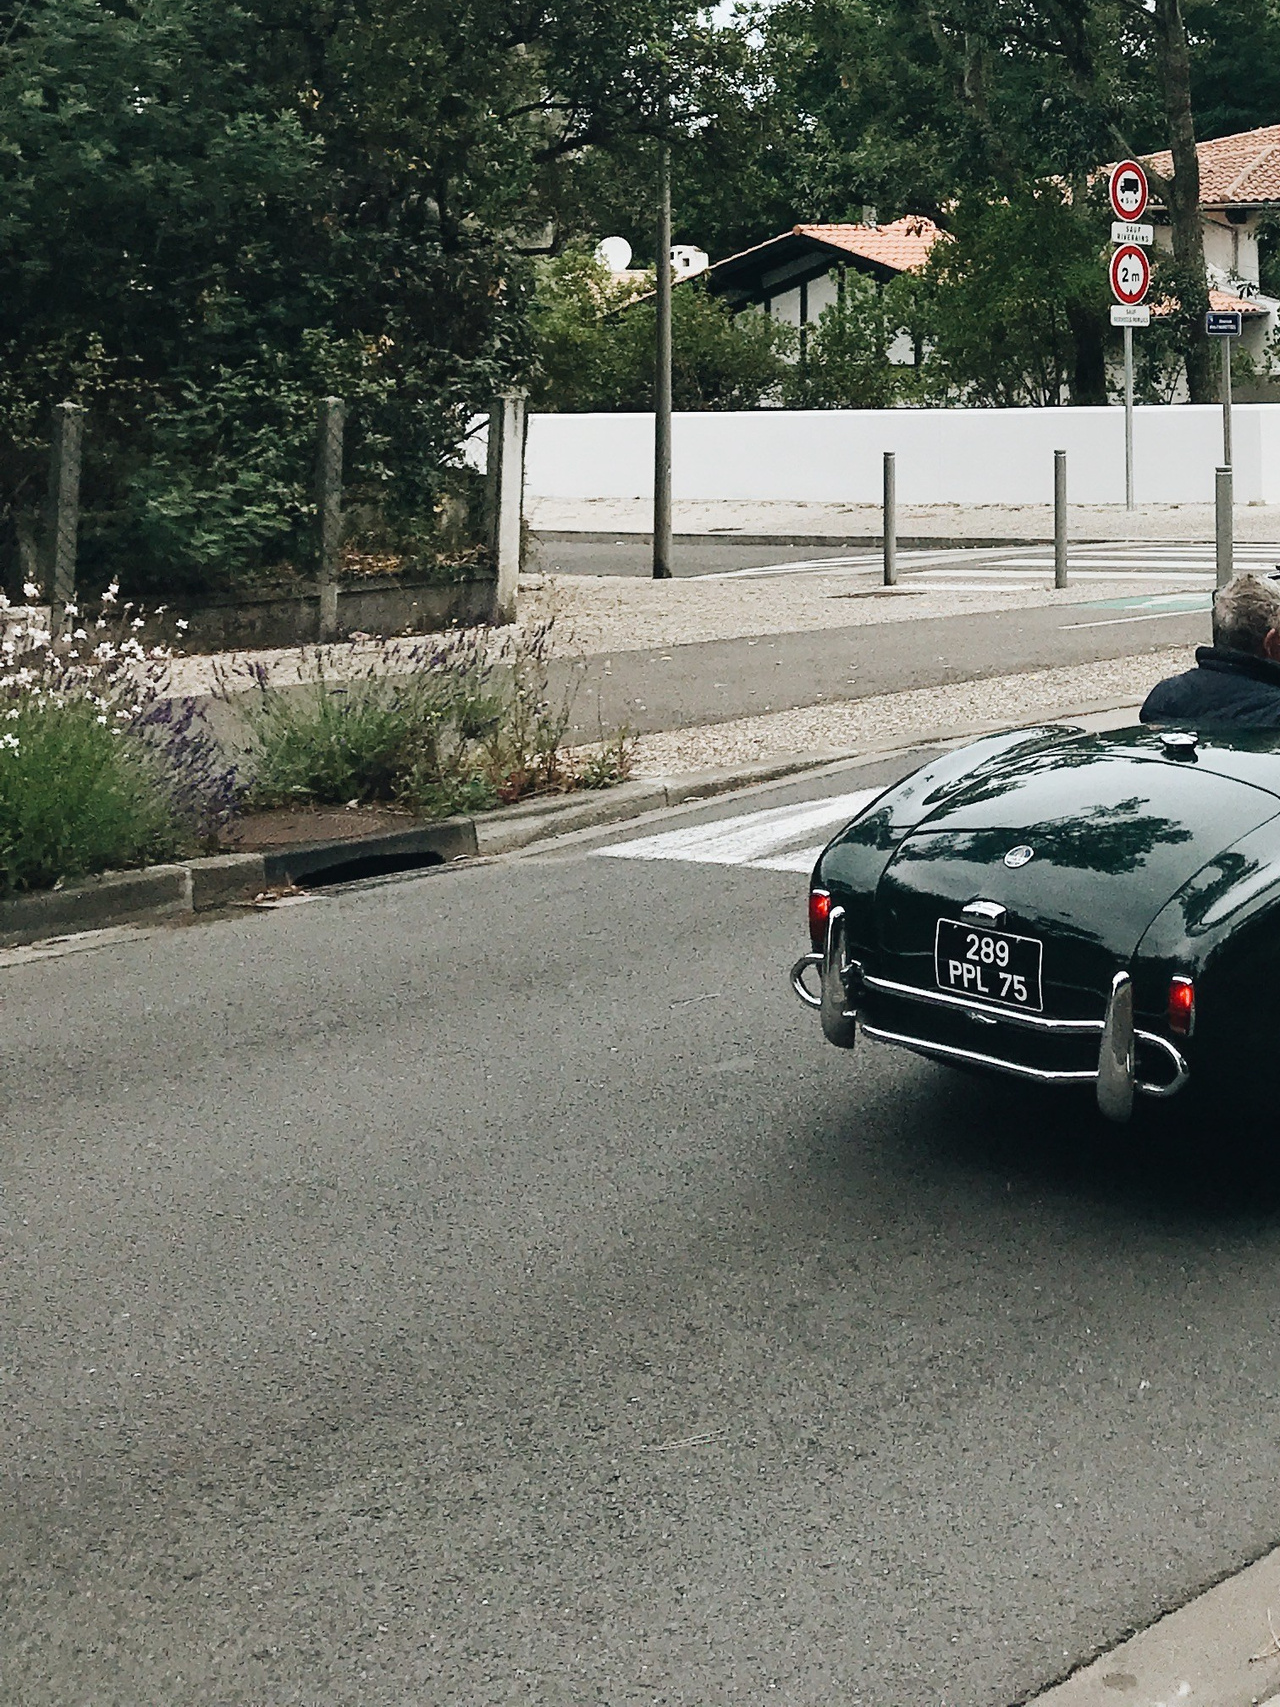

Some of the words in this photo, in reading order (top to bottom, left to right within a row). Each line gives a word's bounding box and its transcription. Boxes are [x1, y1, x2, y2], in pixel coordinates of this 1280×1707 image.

[1126, 225, 1141, 233] SAUF
[1117, 233, 1149, 243] RIVERAINS
[1122, 267, 1129, 283] 2
[1131, 273, 1140, 282] m
[966, 933, 1009, 967] 289
[949, 959, 989, 993] PPL
[999, 972, 1027, 1001] 75
